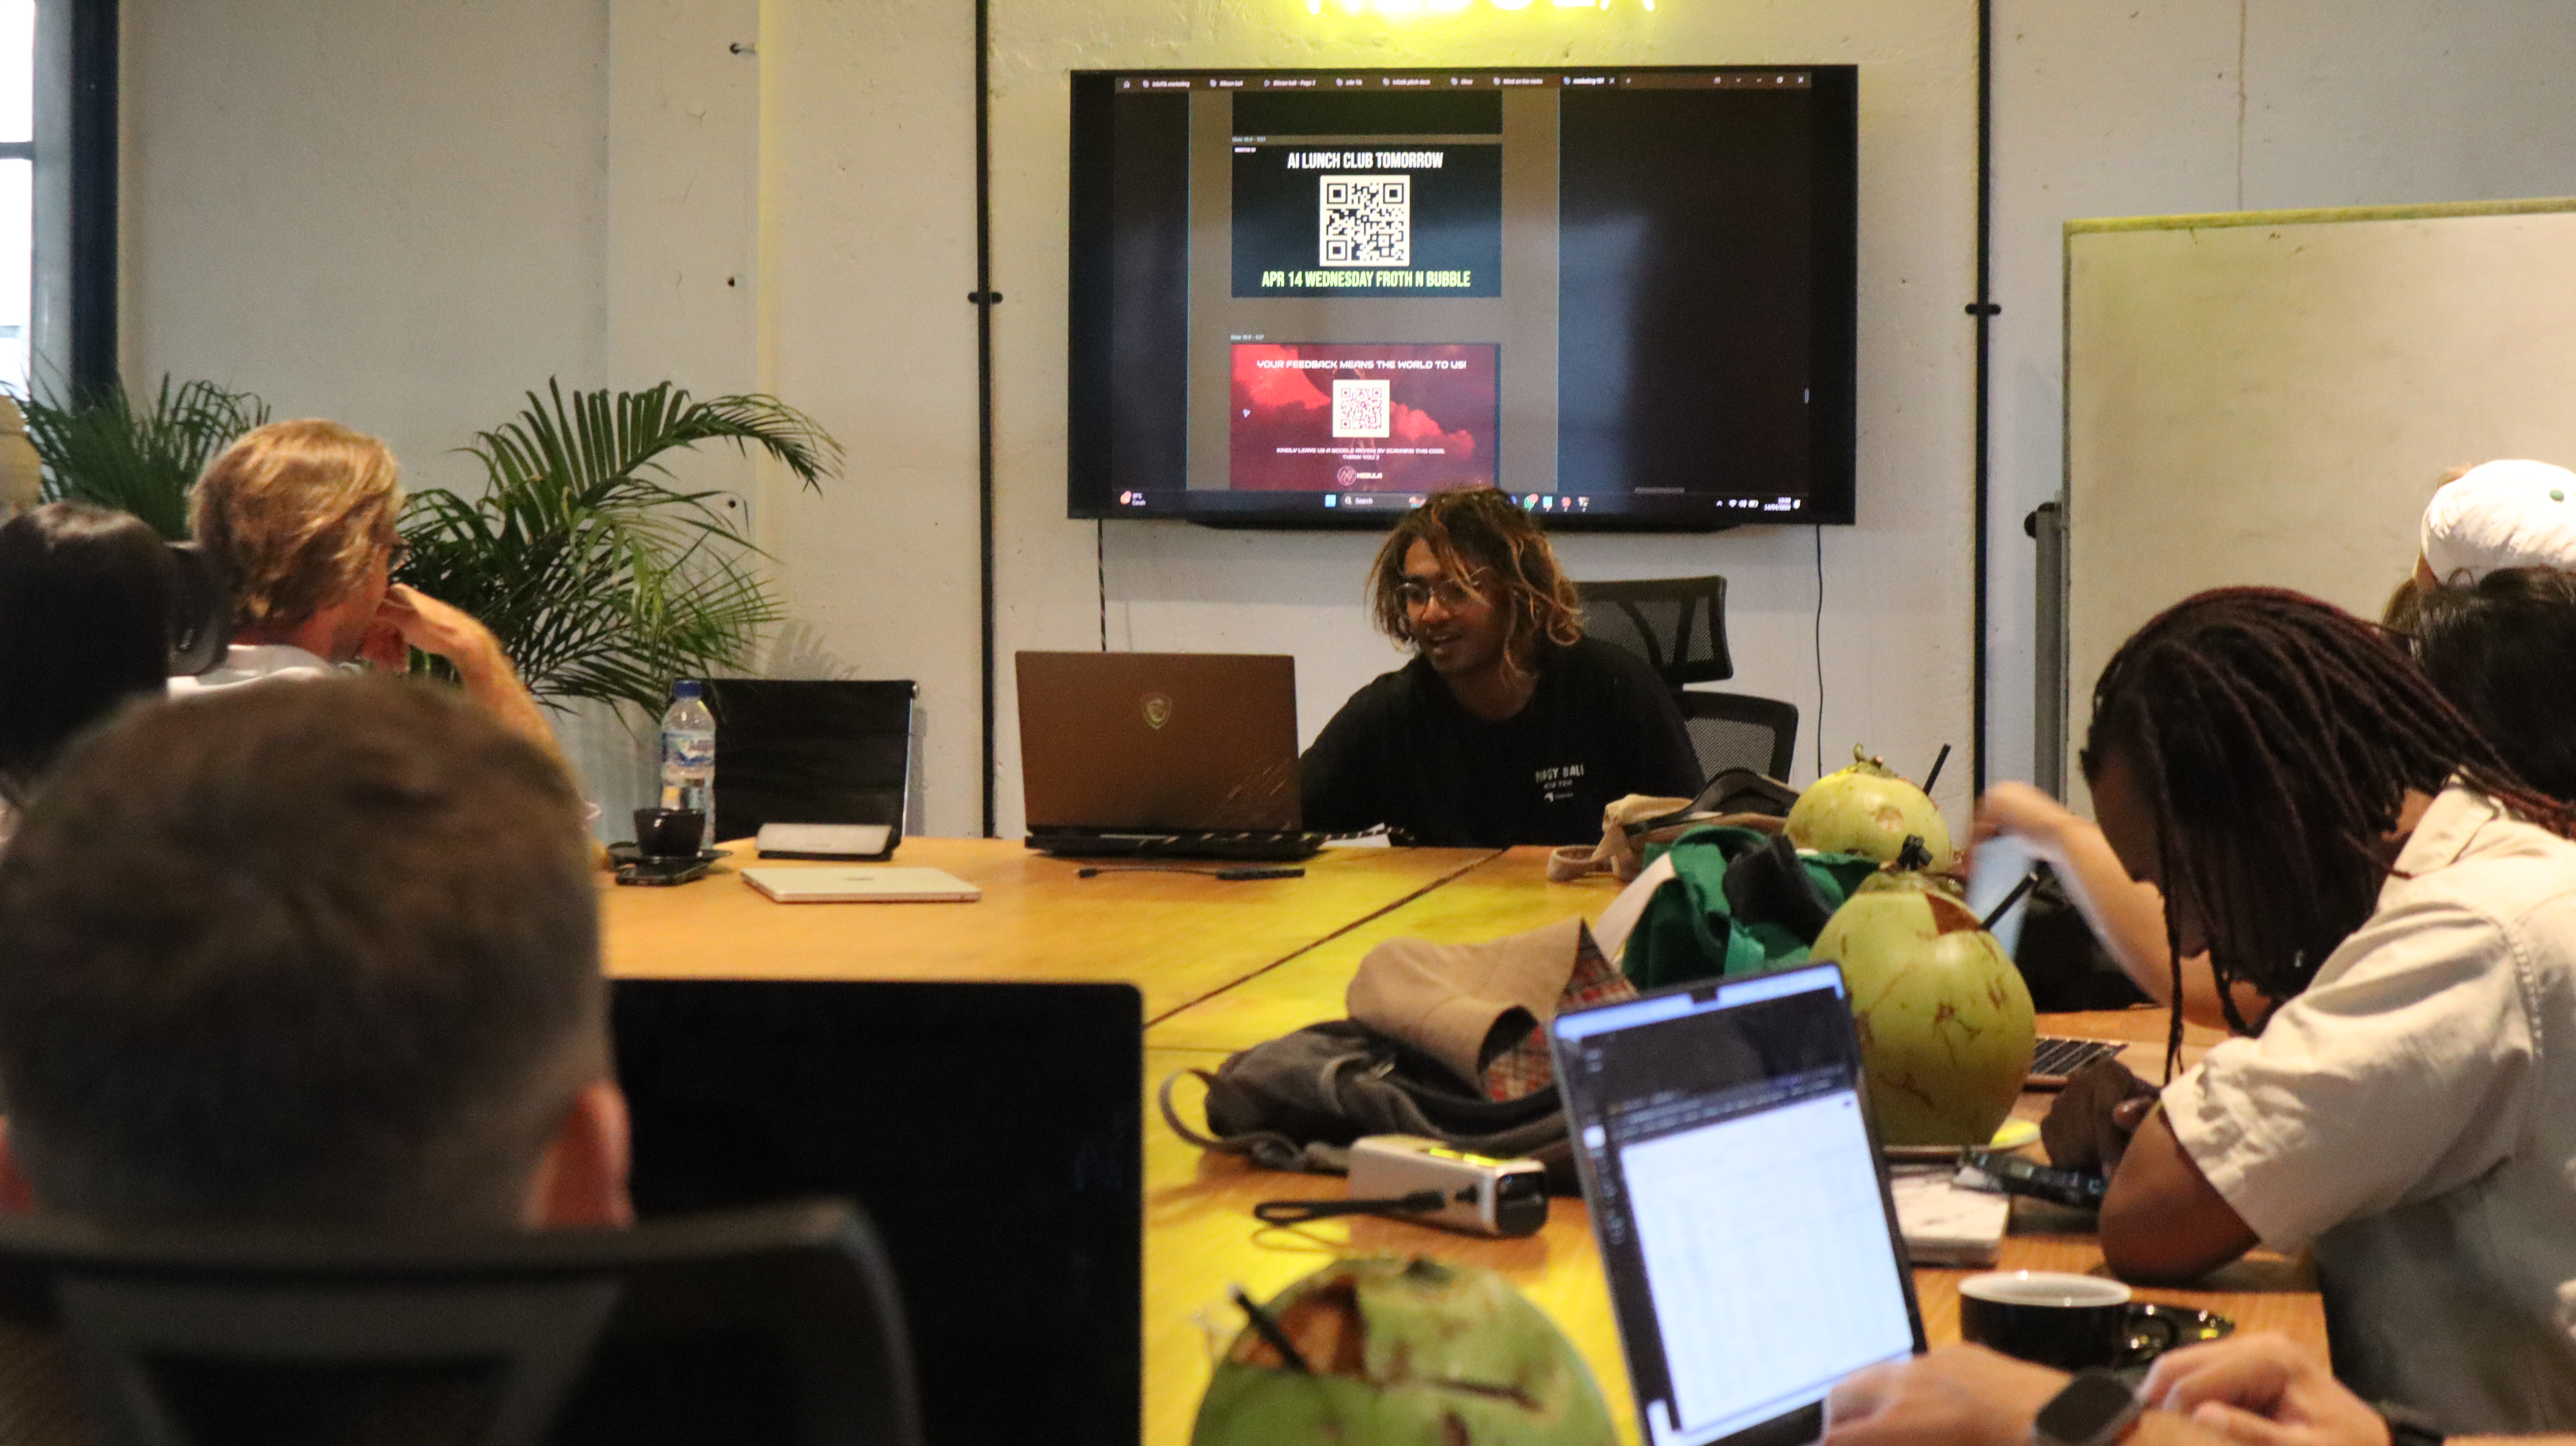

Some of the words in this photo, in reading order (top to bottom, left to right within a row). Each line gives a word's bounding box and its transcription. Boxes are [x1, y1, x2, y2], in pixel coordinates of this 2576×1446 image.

[1287, 152, 1300, 169] AI
[1302, 152, 1341, 169] LUNCH
[1343, 152, 1373, 169] CLUB
[1375, 152, 1444, 169] TOMORROW
[1261, 270, 1285, 287] APR
[1288, 270, 1303, 287] 14
[1305, 270, 1374, 287] WEDNESDAY
[1376, 270, 1412, 287] FROTH
[1415, 270, 1424, 287] N
[1426, 270, 1471, 287] BUBBLE
[1256, 360, 1285, 369] YOUR
[1286, 360, 1338, 369] FEEDBACK
[1340, 360, 1374, 369] MEANS
[1376, 360, 1396, 369] THE
[1397, 360, 1433, 369] WORLD
[1435, 360, 1449, 369] TO
[1450, 360, 1467, 369] US!
